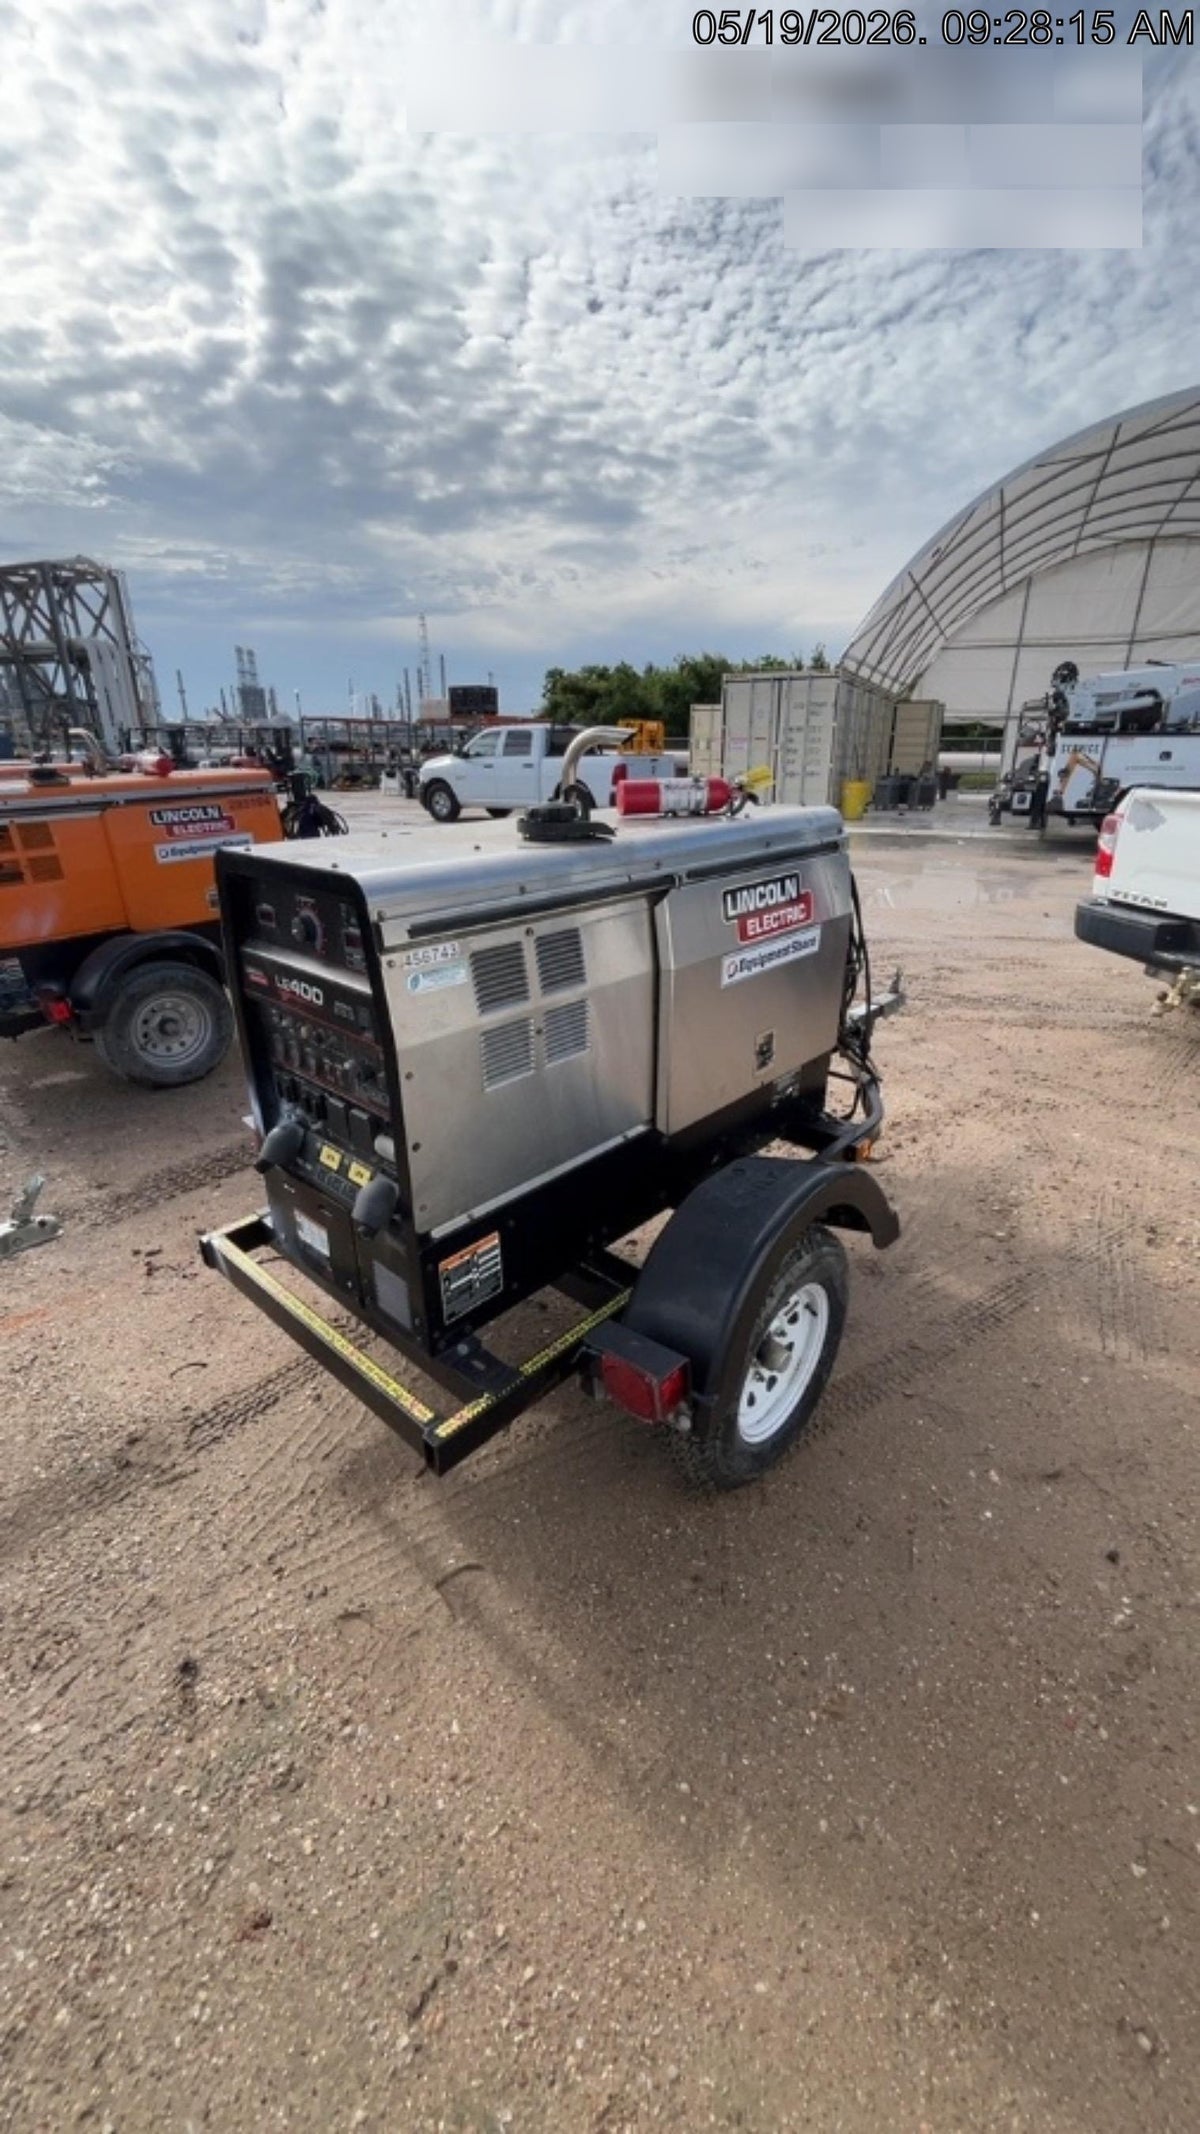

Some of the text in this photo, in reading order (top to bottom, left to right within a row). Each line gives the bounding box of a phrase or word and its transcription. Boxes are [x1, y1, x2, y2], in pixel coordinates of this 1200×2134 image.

[153, 807, 221, 824] LINCOLN
[172, 820, 231, 835] ELECTRIC
[727, 877, 798, 917] LINCOLN
[1112, 890, 1168, 909] TITAN
[746, 903, 807, 937] ELECTRIC
[405, 943, 457, 966] 456743
